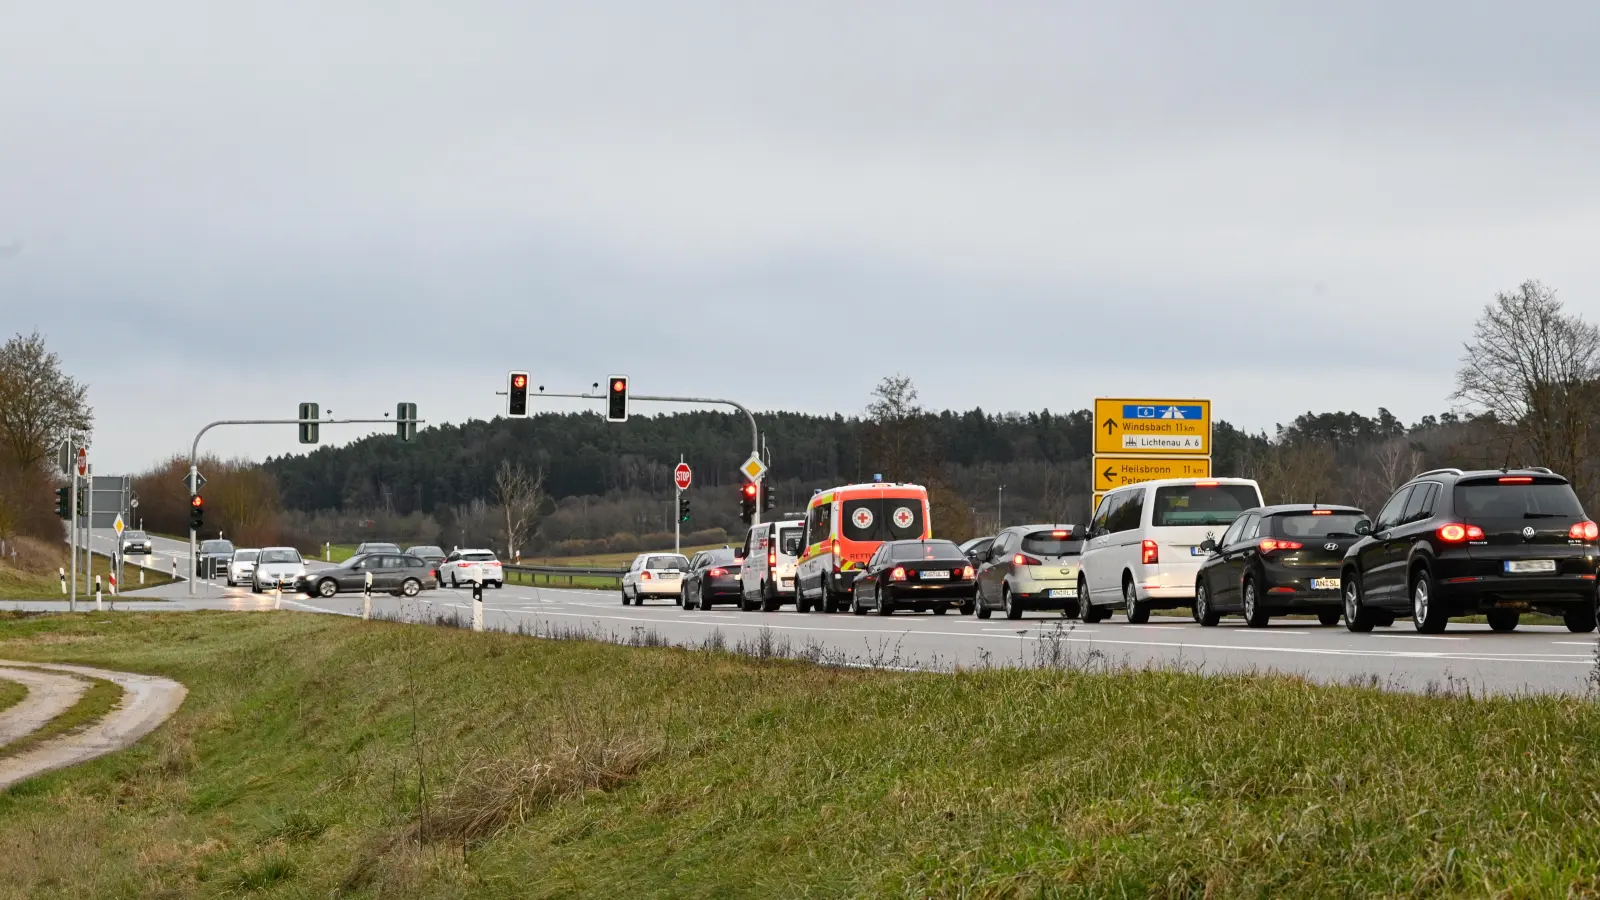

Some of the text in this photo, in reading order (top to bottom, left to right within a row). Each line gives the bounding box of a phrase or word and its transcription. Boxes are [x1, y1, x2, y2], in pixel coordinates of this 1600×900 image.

[1143, 408, 1149, 416] 6
[1122, 422, 1195, 432] Windsbach 11 km
[1141, 438, 1200, 447] Lichtenau A 6
[1121, 464, 1171, 474] Heilsbronn
[1183, 465, 1191, 474] 11
[676, 470, 690, 482] STOP
